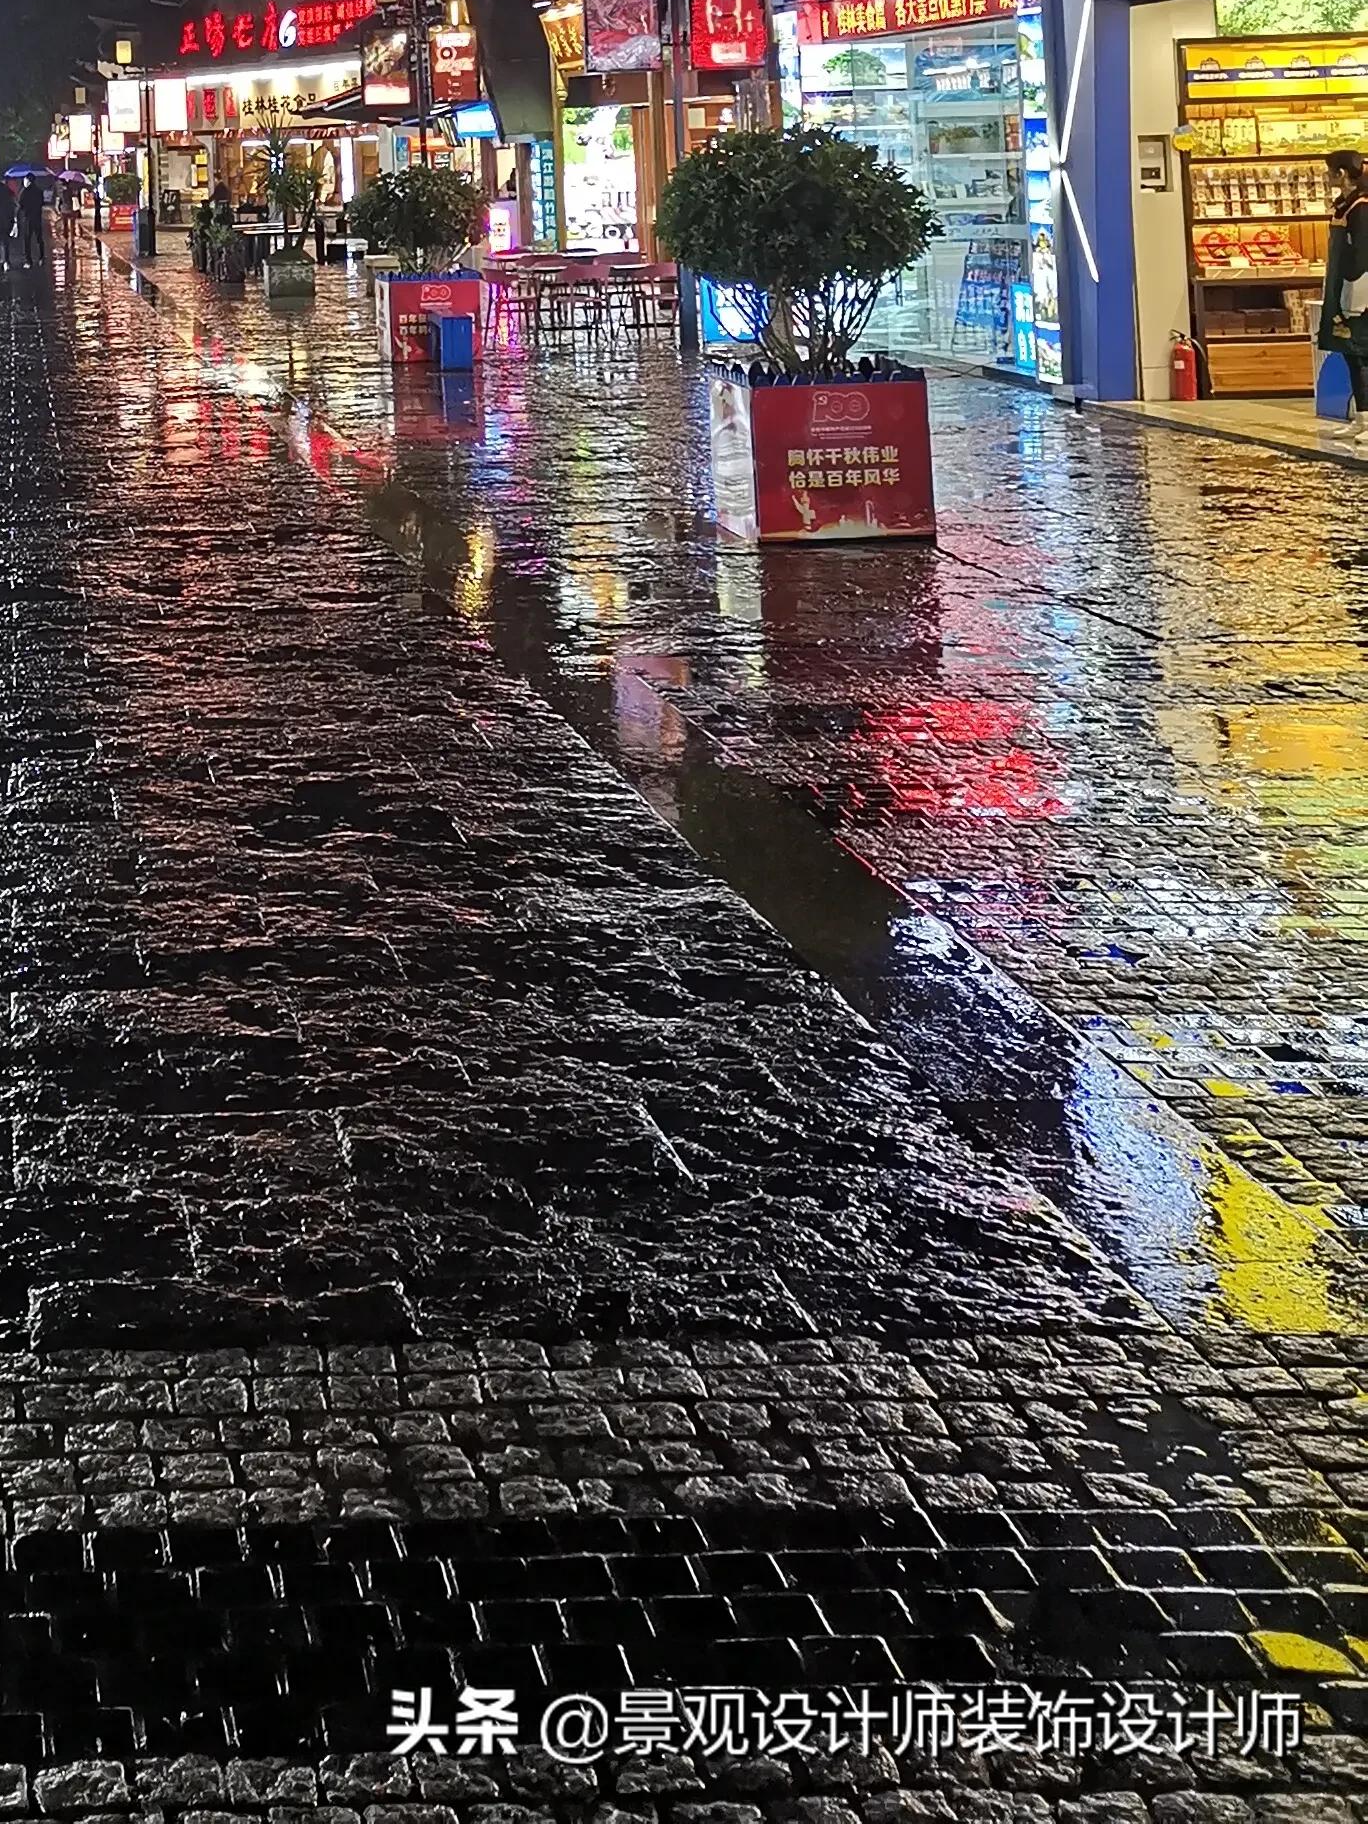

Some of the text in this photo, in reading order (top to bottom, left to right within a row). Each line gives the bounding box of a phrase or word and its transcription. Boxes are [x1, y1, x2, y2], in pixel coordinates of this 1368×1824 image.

[787, 445, 900, 467] 胸怀千秋伟业
[788, 468, 901, 489] 恰是百年风华
